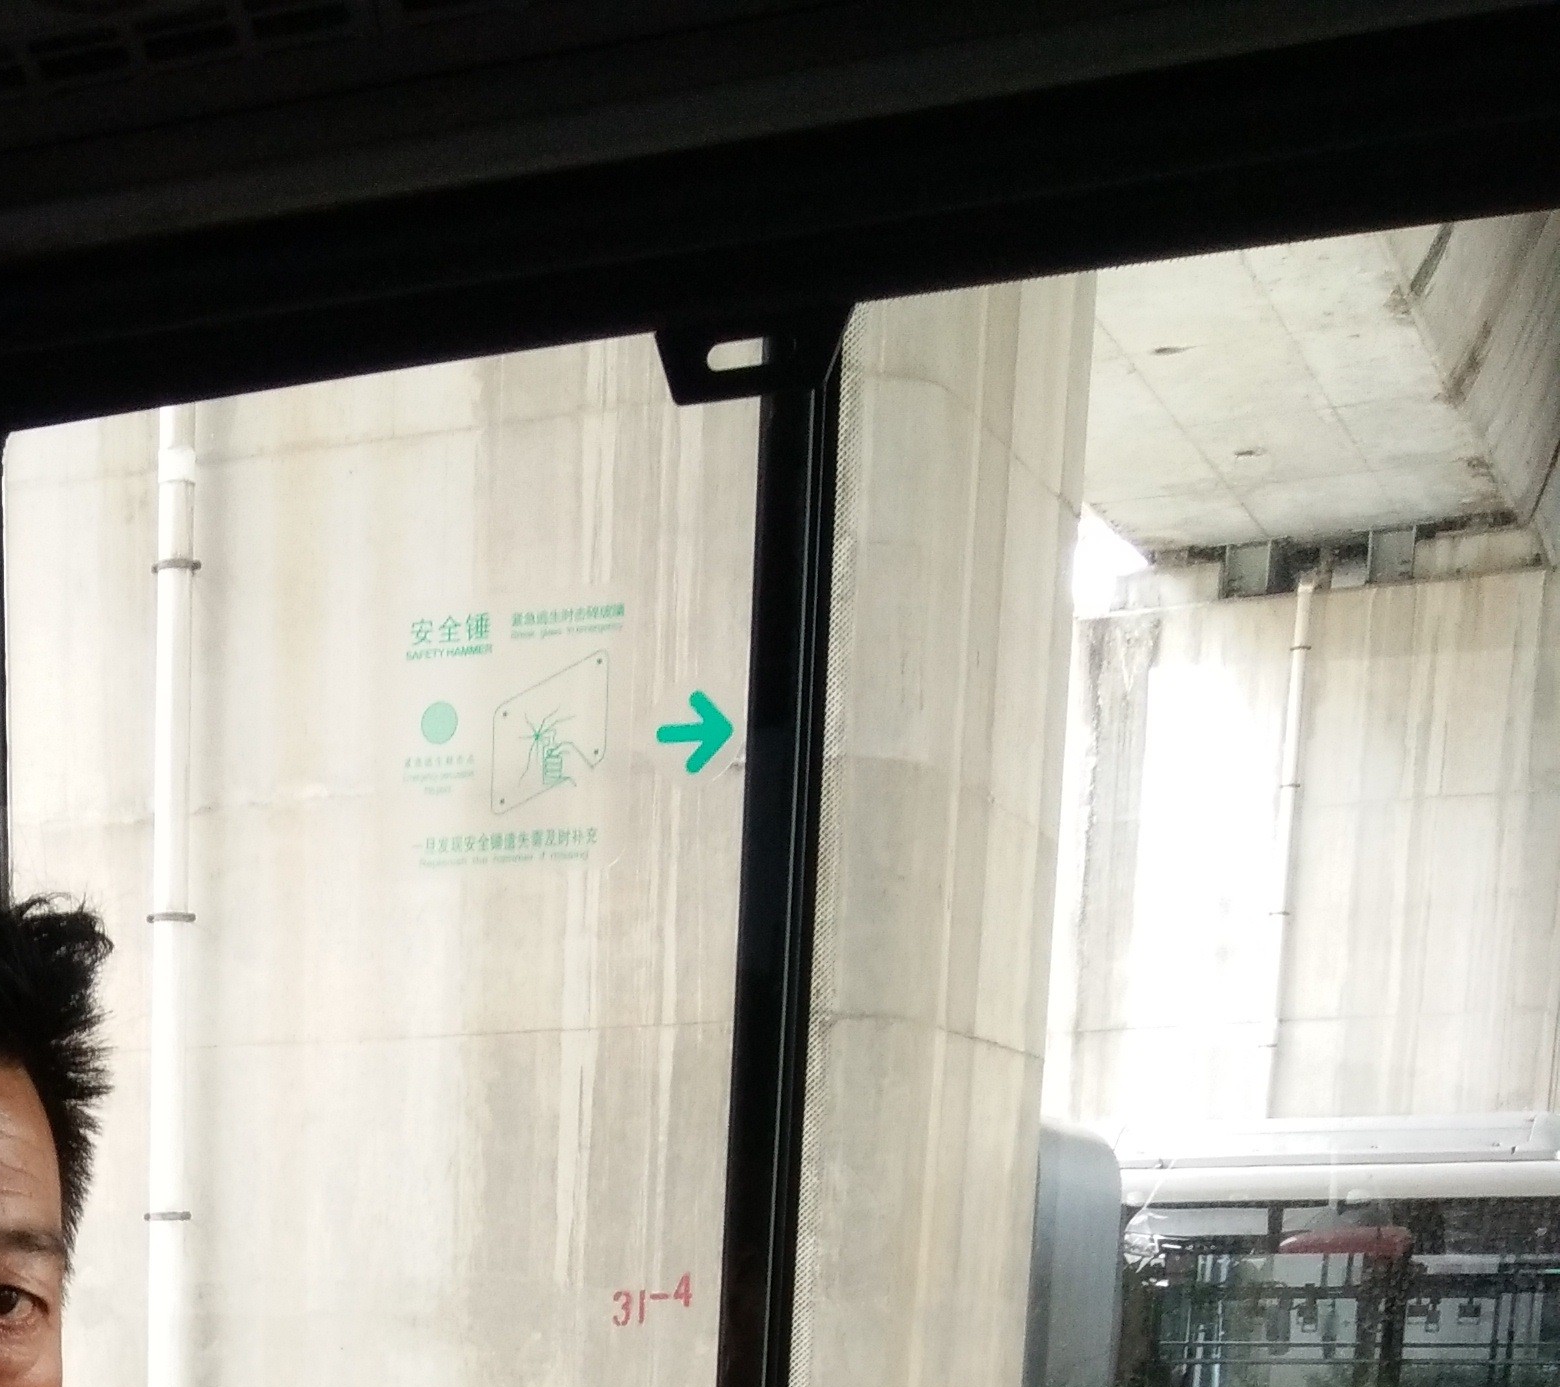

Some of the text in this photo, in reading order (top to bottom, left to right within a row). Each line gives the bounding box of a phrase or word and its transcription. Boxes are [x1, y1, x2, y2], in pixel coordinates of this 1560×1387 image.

[411, 612, 490, 645] 安全锤
[406, 643, 493, 661] SAFETY HAMMER
[612, 1272, 692, 1326] 31-4
